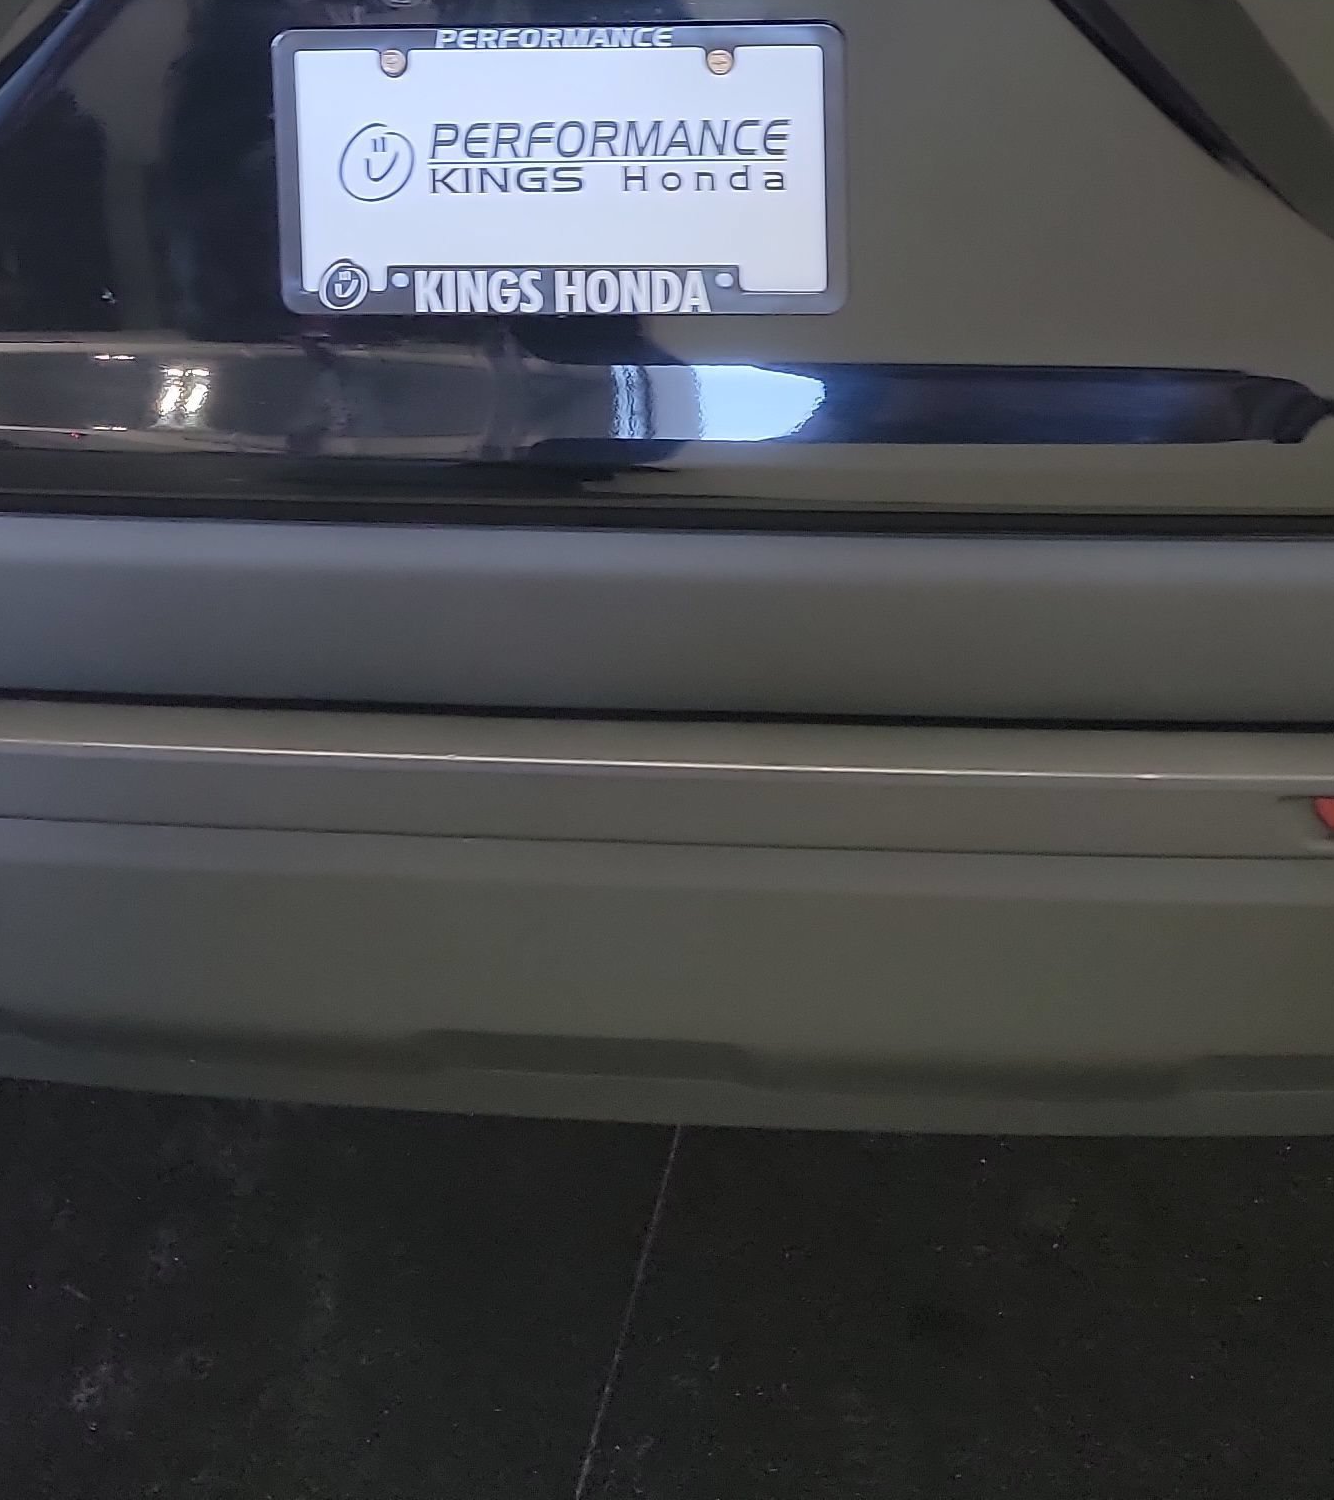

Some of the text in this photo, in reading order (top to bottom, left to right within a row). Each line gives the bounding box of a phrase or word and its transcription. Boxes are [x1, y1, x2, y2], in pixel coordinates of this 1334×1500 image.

[435, 27, 673, 49] PERFORMANCE
[431, 119, 791, 158] PERFORMANCE
[430, 165, 787, 194] KINGS Honda
[414, 270, 712, 313] KINGS HONDA
